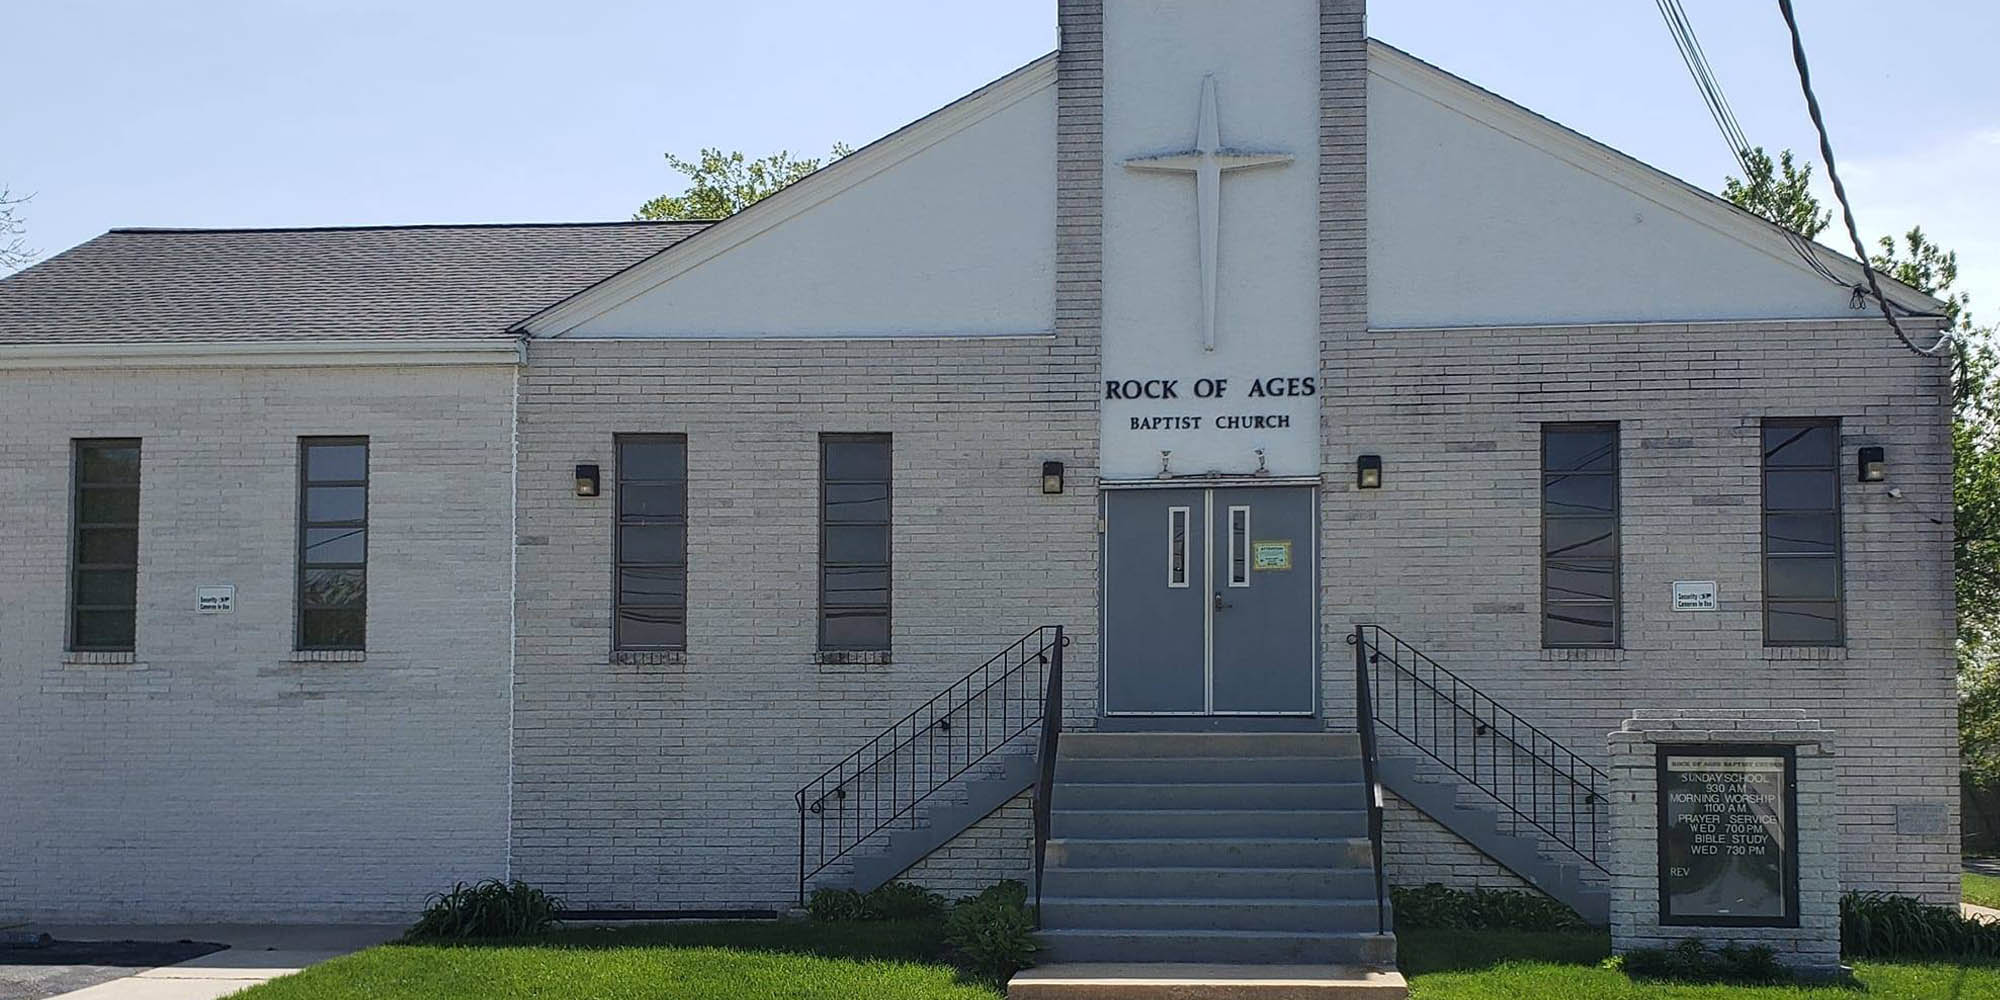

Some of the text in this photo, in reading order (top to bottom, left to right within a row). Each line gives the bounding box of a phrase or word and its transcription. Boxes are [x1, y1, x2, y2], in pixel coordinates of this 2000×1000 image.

[1105, 376, 1316, 400] ROCK OF AGES
[1130, 415, 1290, 430] BAPTIST CHURCH
[1681, 773, 1771, 783] SUNDAY SCHOOL
[1706, 784, 1747, 793] 930 AM
[1670, 794, 1776, 803] MORNING WORSHIP
[1704, 804, 1747, 813] 1100 AM
[1678, 814, 1778, 824] PRAYER SERVICE
[1690, 824, 1763, 833] WED 700 PM
[1695, 834, 1769, 844] BIBLE STUDY
[1691, 845, 1765, 855] WED 730 PM
[1670, 867, 1690, 877] REV
